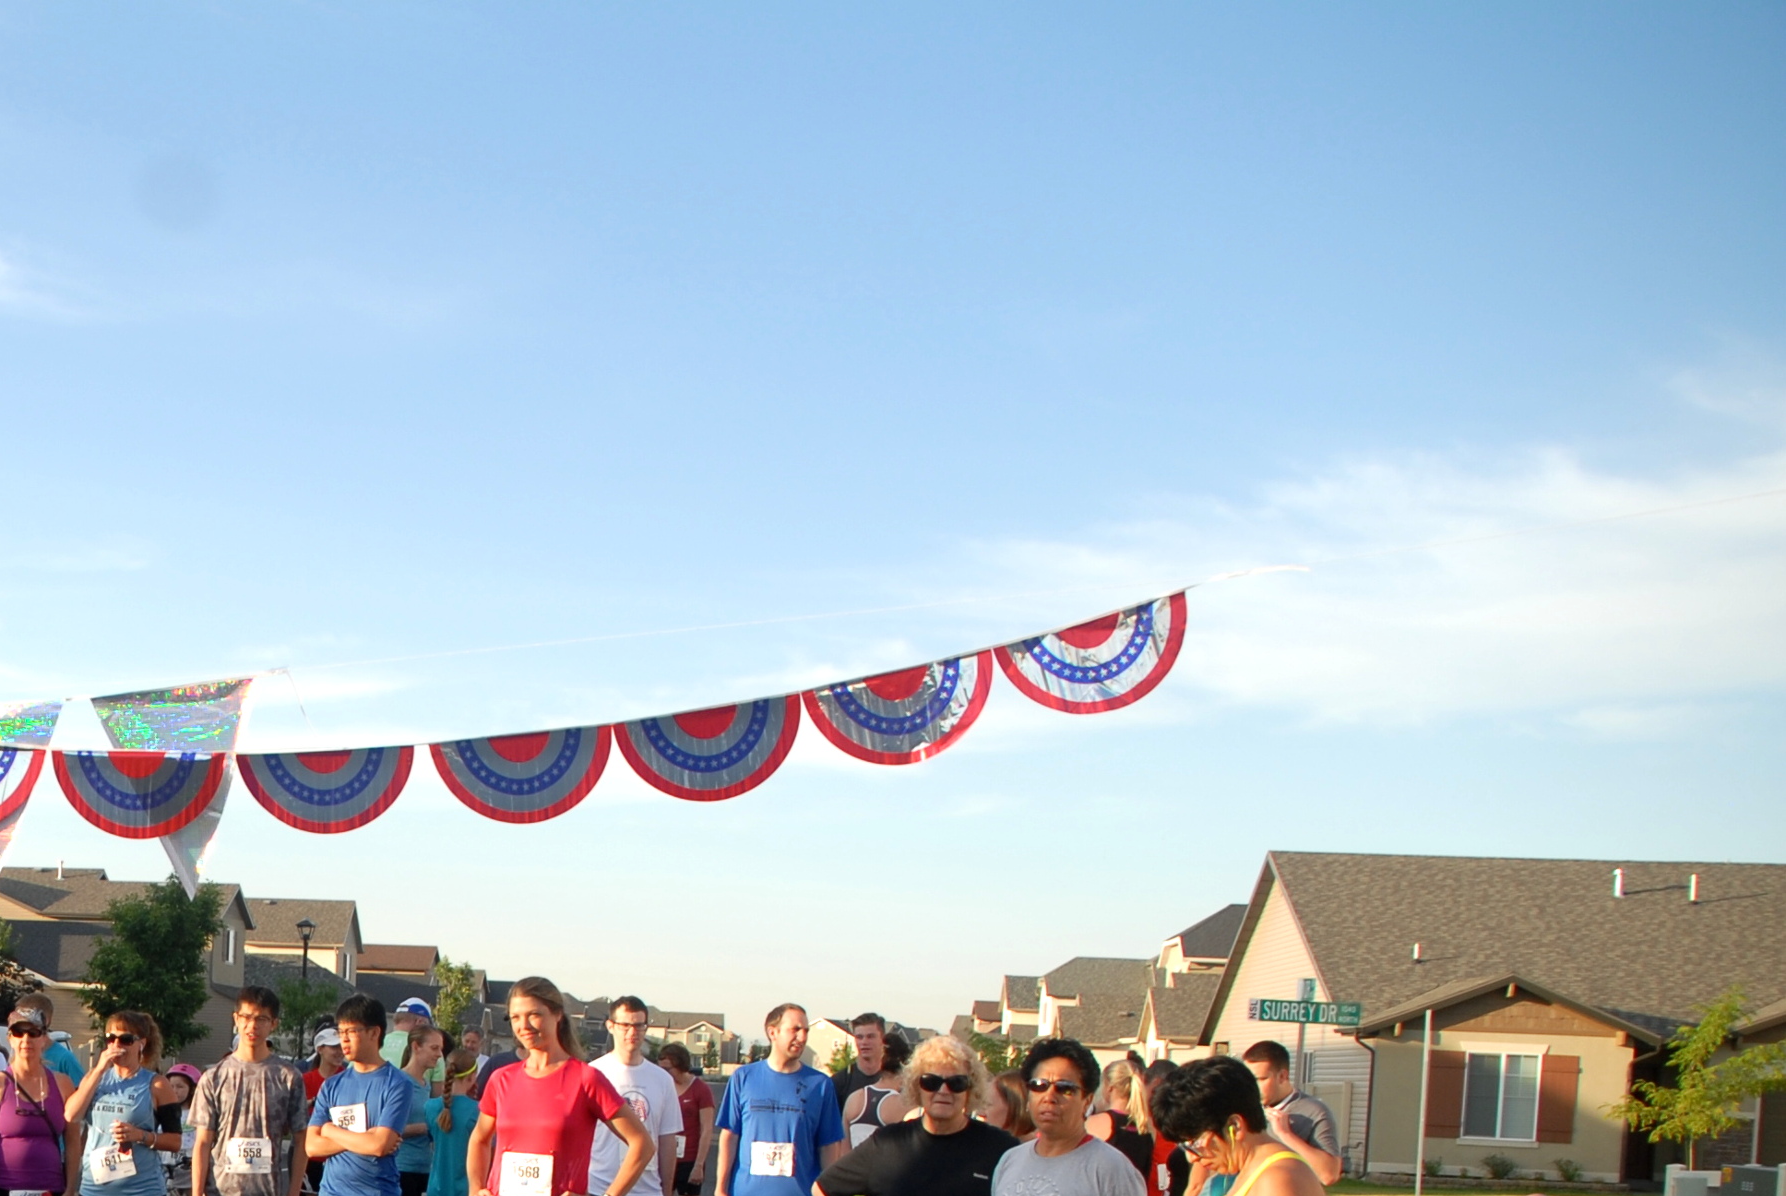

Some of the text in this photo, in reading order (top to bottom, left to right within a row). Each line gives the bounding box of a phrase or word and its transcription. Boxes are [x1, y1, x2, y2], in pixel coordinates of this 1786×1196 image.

[1248, 1000, 1258, 1019] NSL
[1262, 1001, 1337, 1022] SURREY DR
[238, 1147, 262, 1158] 1558
